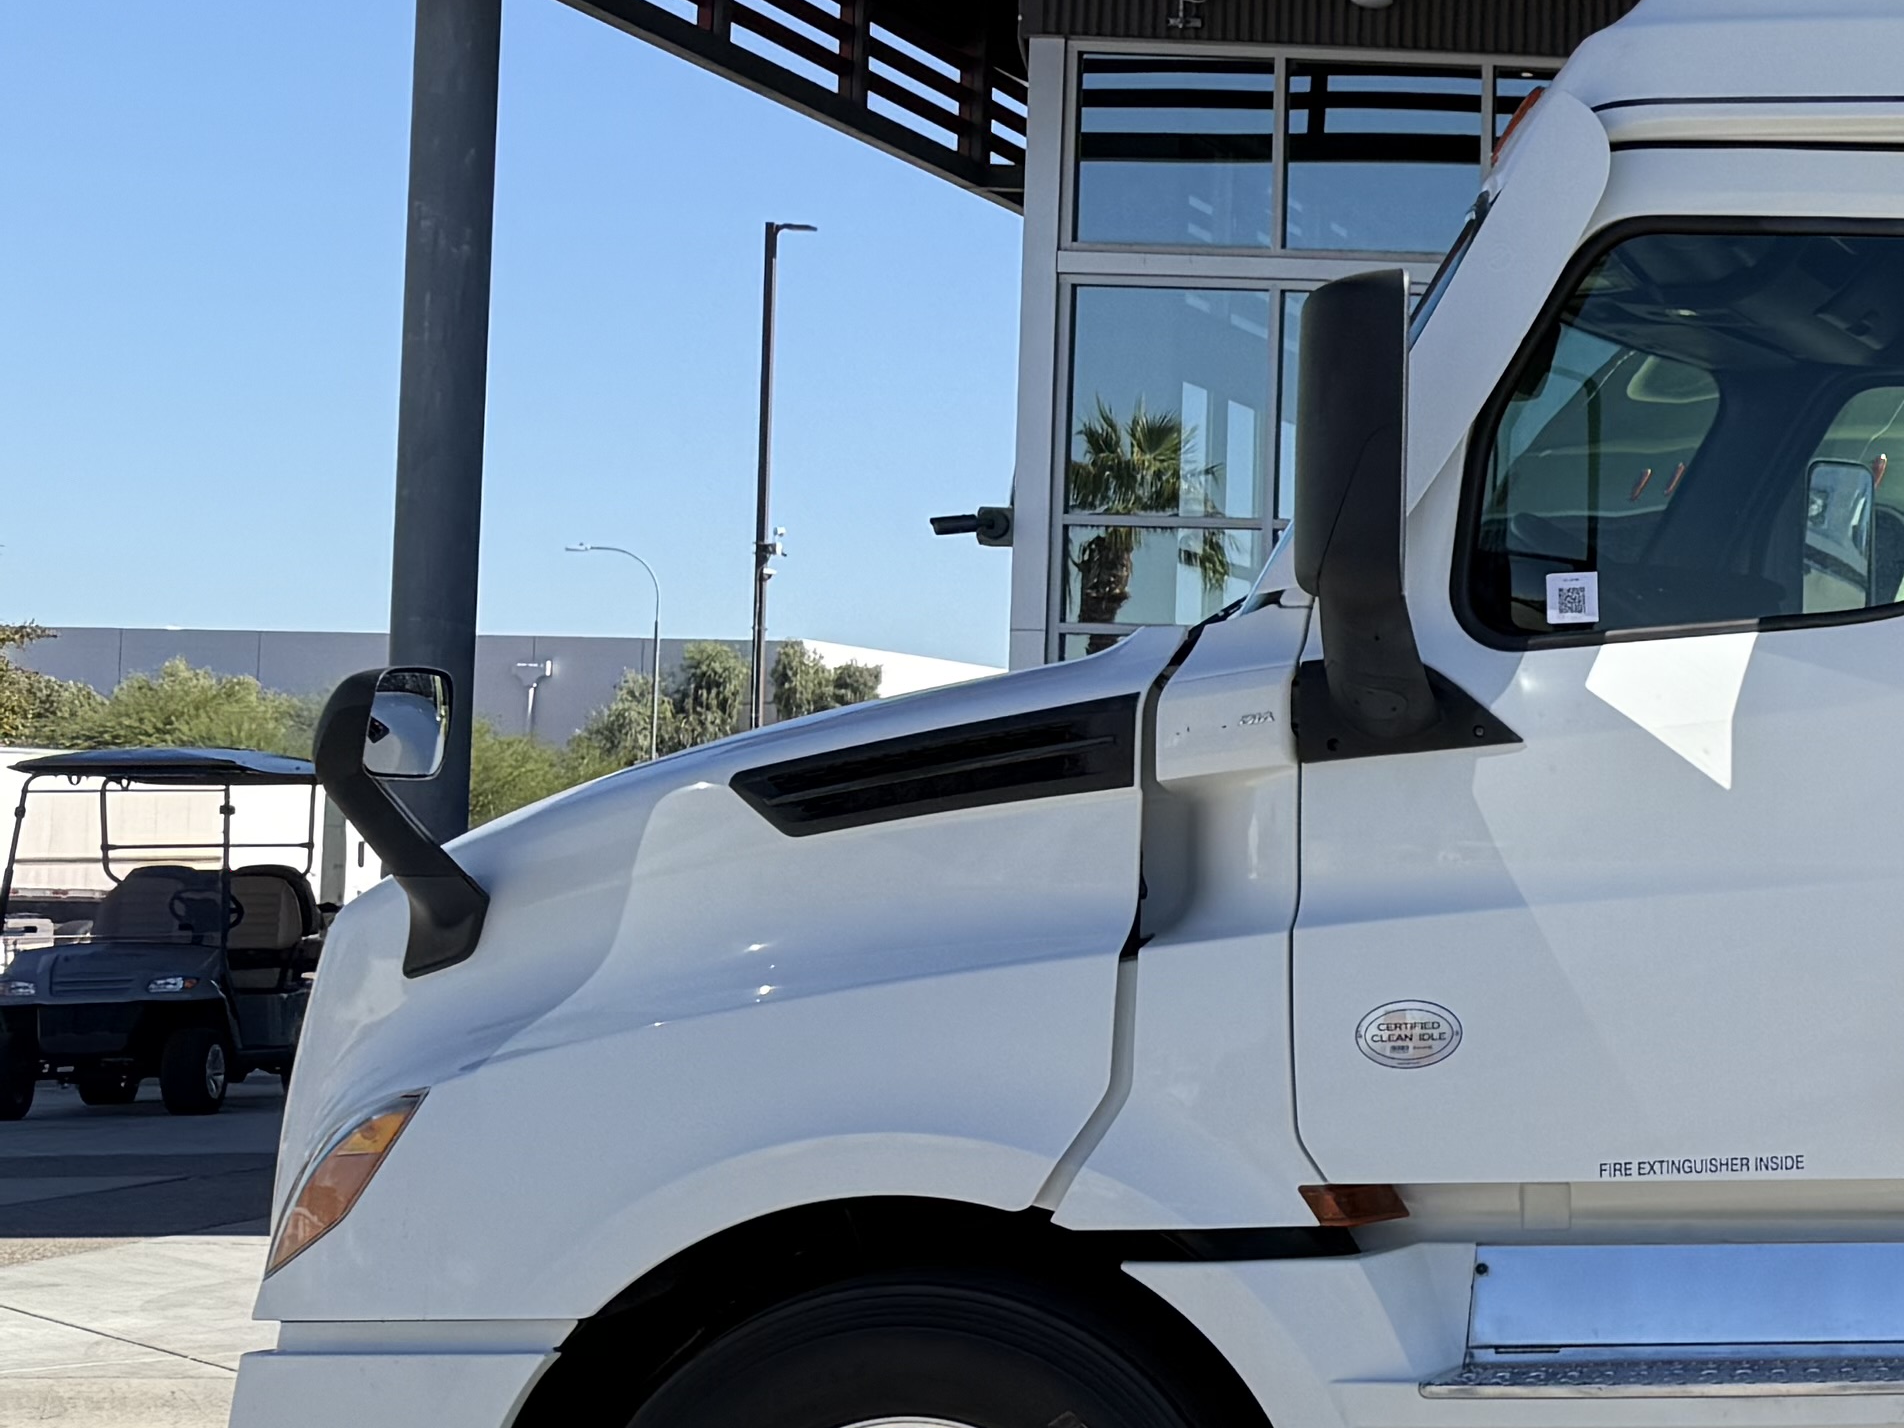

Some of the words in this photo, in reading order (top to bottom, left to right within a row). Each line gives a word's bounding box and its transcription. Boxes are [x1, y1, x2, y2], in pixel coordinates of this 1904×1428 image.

[1377, 1021, 1440, 1032] CERTIFIED
[1371, 1033, 1413, 1043] CLEAN
[1418, 1032, 1447, 1042] IDLE
[1600, 1162, 1632, 1178] FIRE
[1637, 1157, 1750, 1176] EXTINGUISHER
[1754, 1155, 1804, 1172] INSIDE
